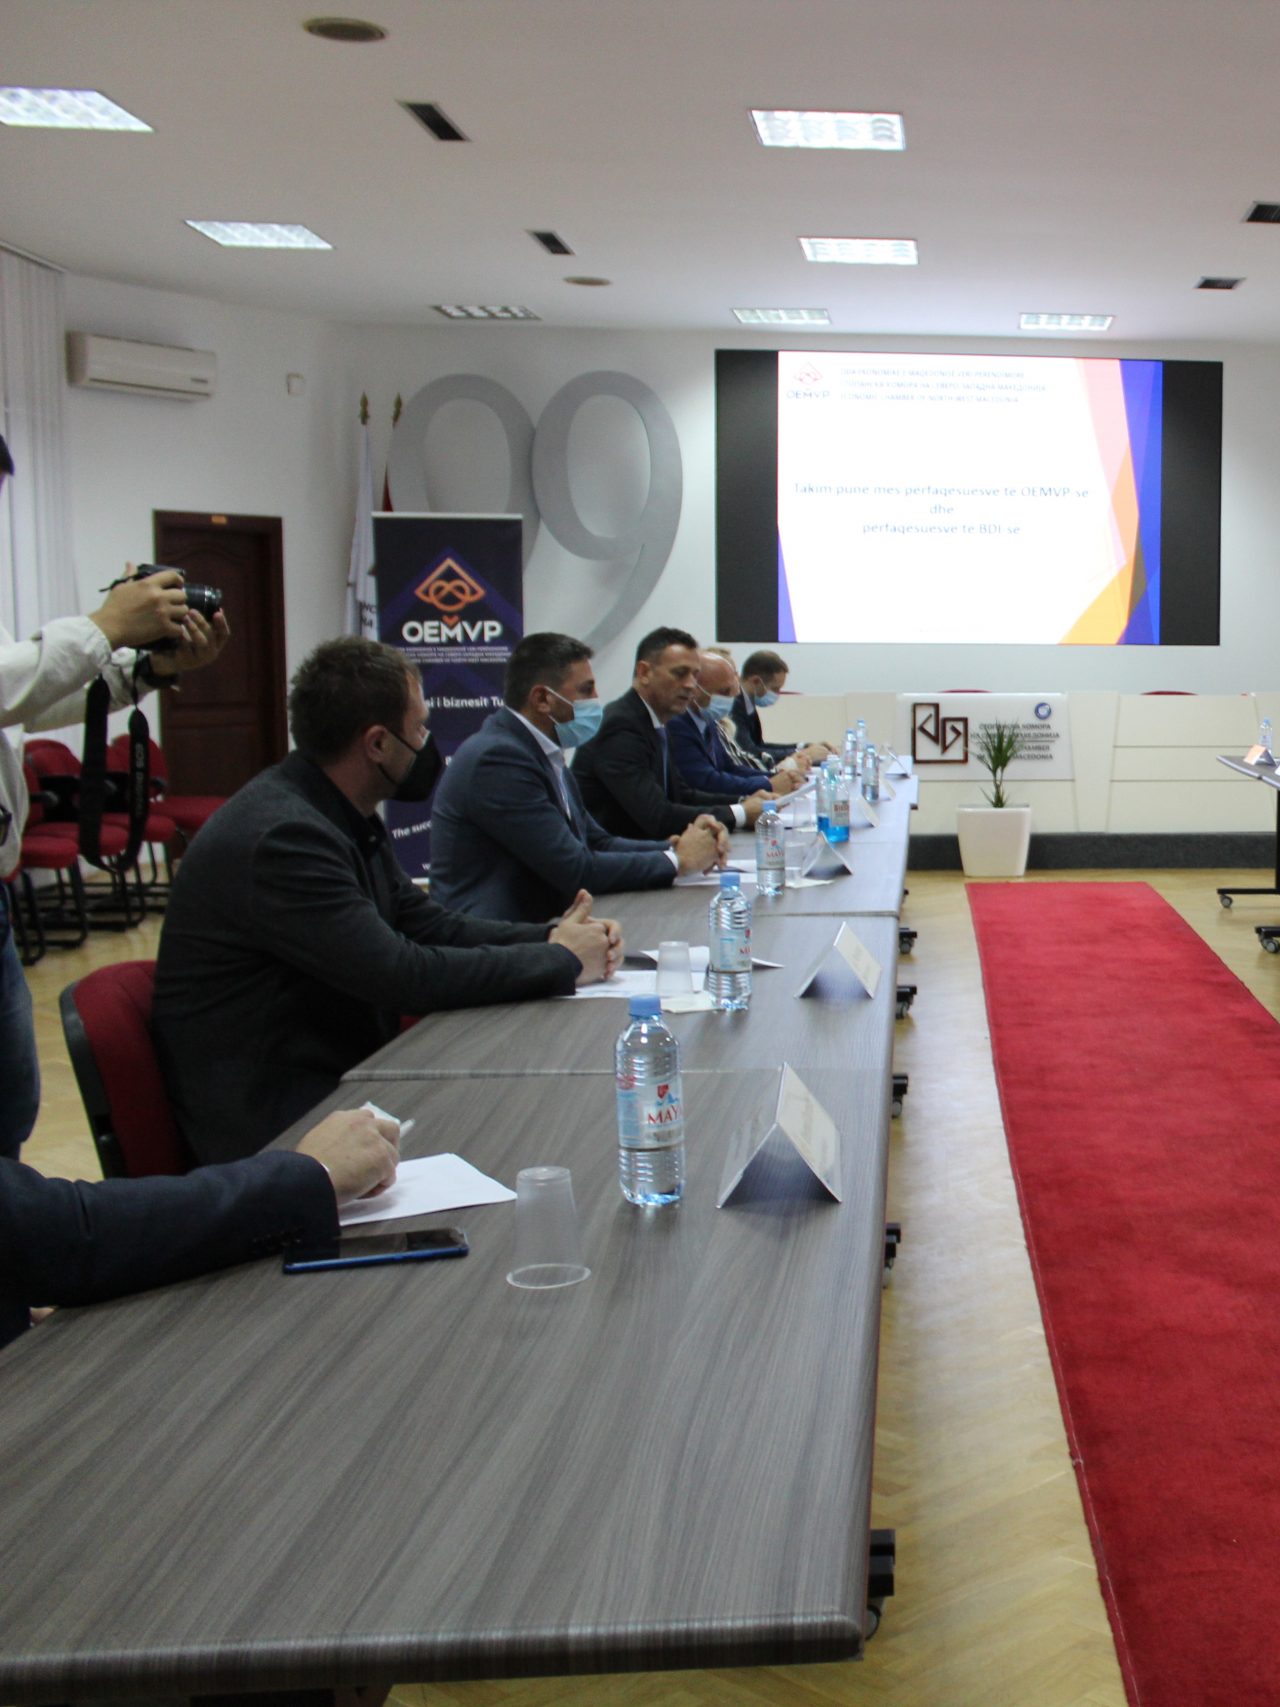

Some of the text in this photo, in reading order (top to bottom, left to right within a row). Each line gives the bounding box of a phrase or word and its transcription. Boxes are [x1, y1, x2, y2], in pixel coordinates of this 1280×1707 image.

[785, 388, 831, 401] OEMVP
[836, 485, 869, 497] pune
[873, 486, 901, 495] mes
[929, 503, 954, 515] dhe
[402, 620, 503, 644] OEMVP
[443, 696, 489, 708] biznesit
[392, 827, 411, 839] The
